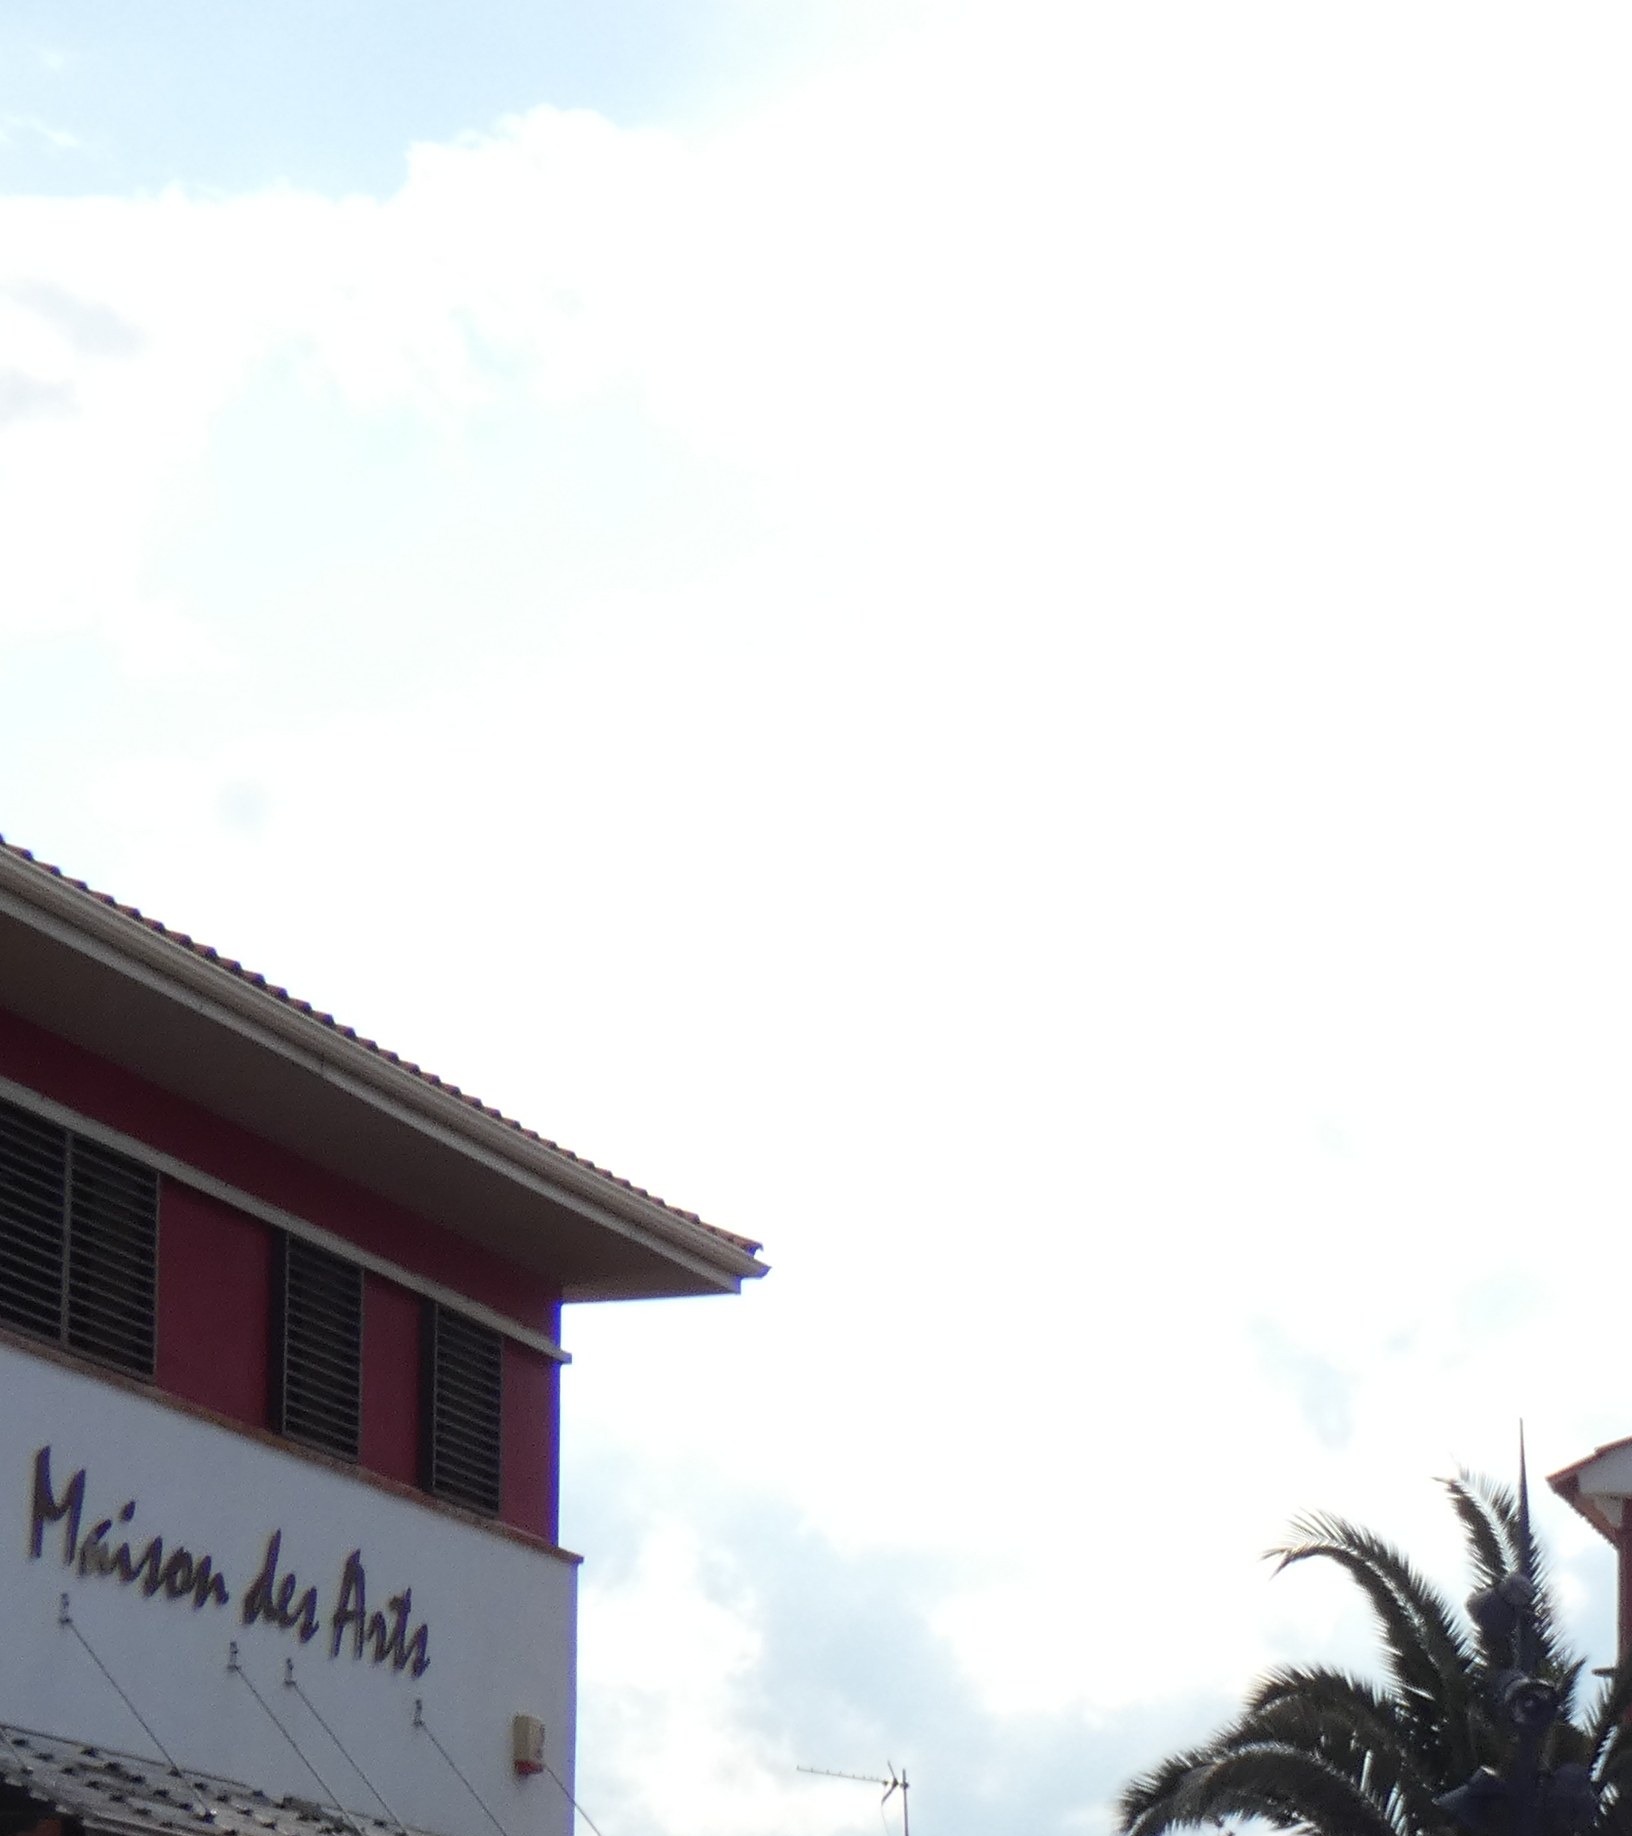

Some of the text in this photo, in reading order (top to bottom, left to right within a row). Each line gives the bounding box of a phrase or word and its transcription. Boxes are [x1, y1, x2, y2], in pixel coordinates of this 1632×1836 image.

[29, 1445, 431, 1679] Maison des Arts
